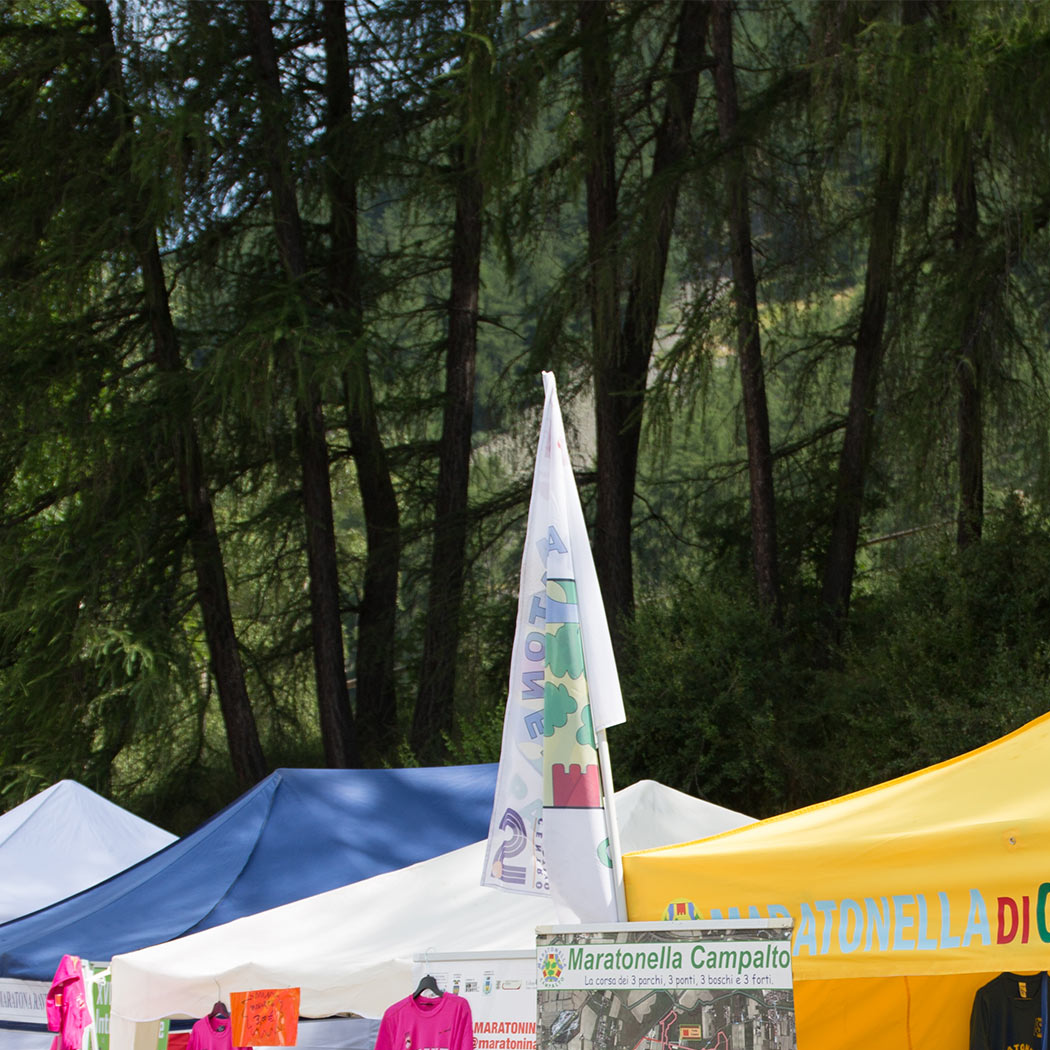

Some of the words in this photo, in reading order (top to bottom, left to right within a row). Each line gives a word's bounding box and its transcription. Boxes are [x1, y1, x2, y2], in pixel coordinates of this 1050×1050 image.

[996, 895, 1029, 946] DI
[568, 946, 682, 970] Maratonella
[691, 944, 790, 974] Campalto
[584, 976, 593, 986] La
[595, 976, 616, 986] corsa
[618, 975, 629, 985] dei
[708, 974, 733, 984] boschi
